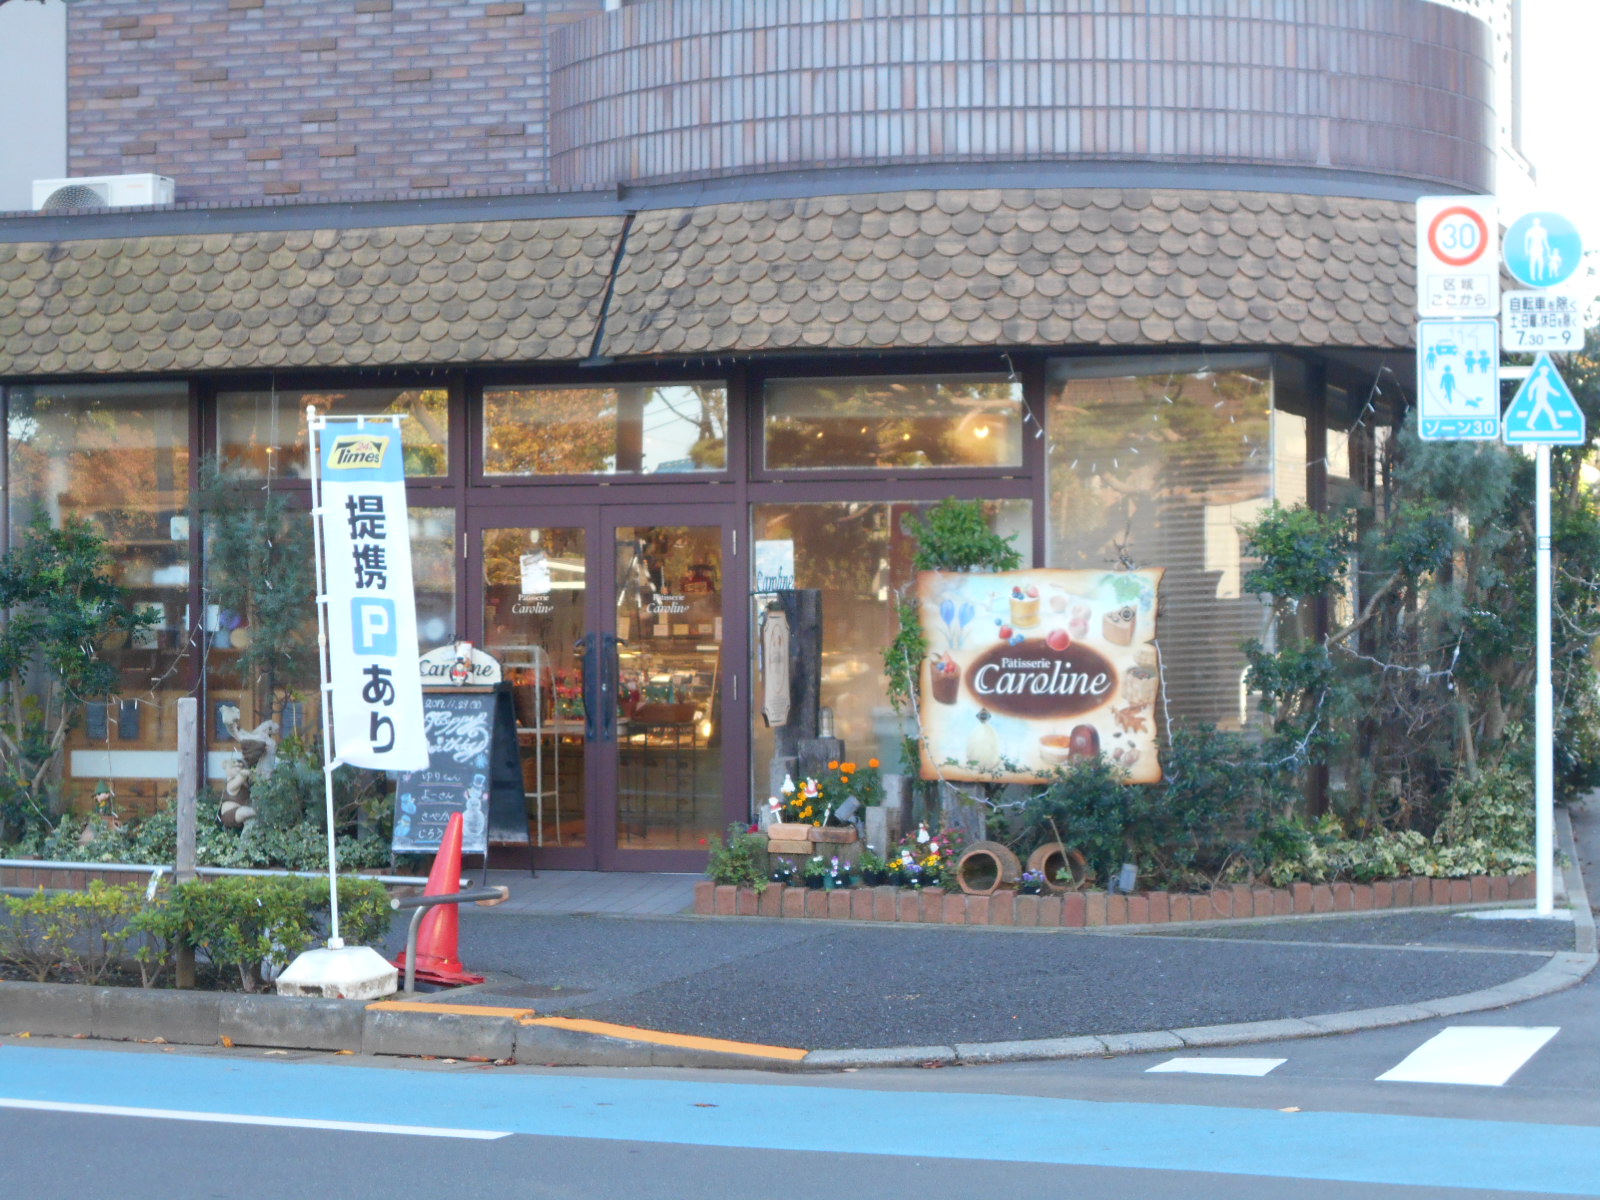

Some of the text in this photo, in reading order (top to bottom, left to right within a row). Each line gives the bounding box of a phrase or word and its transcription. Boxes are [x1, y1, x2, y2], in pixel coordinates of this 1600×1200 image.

[1442, 223, 1475, 249] 30
[1443, 278, 1474, 291] 区域
[1432, 294, 1486, 306] ここから
[336, 448, 380, 464] Times
[512, 601, 554, 614] Caroline
[646, 601, 690, 614] Caroline
[419, 659, 494, 677] Carne
[974, 661, 1112, 695] Caroline
